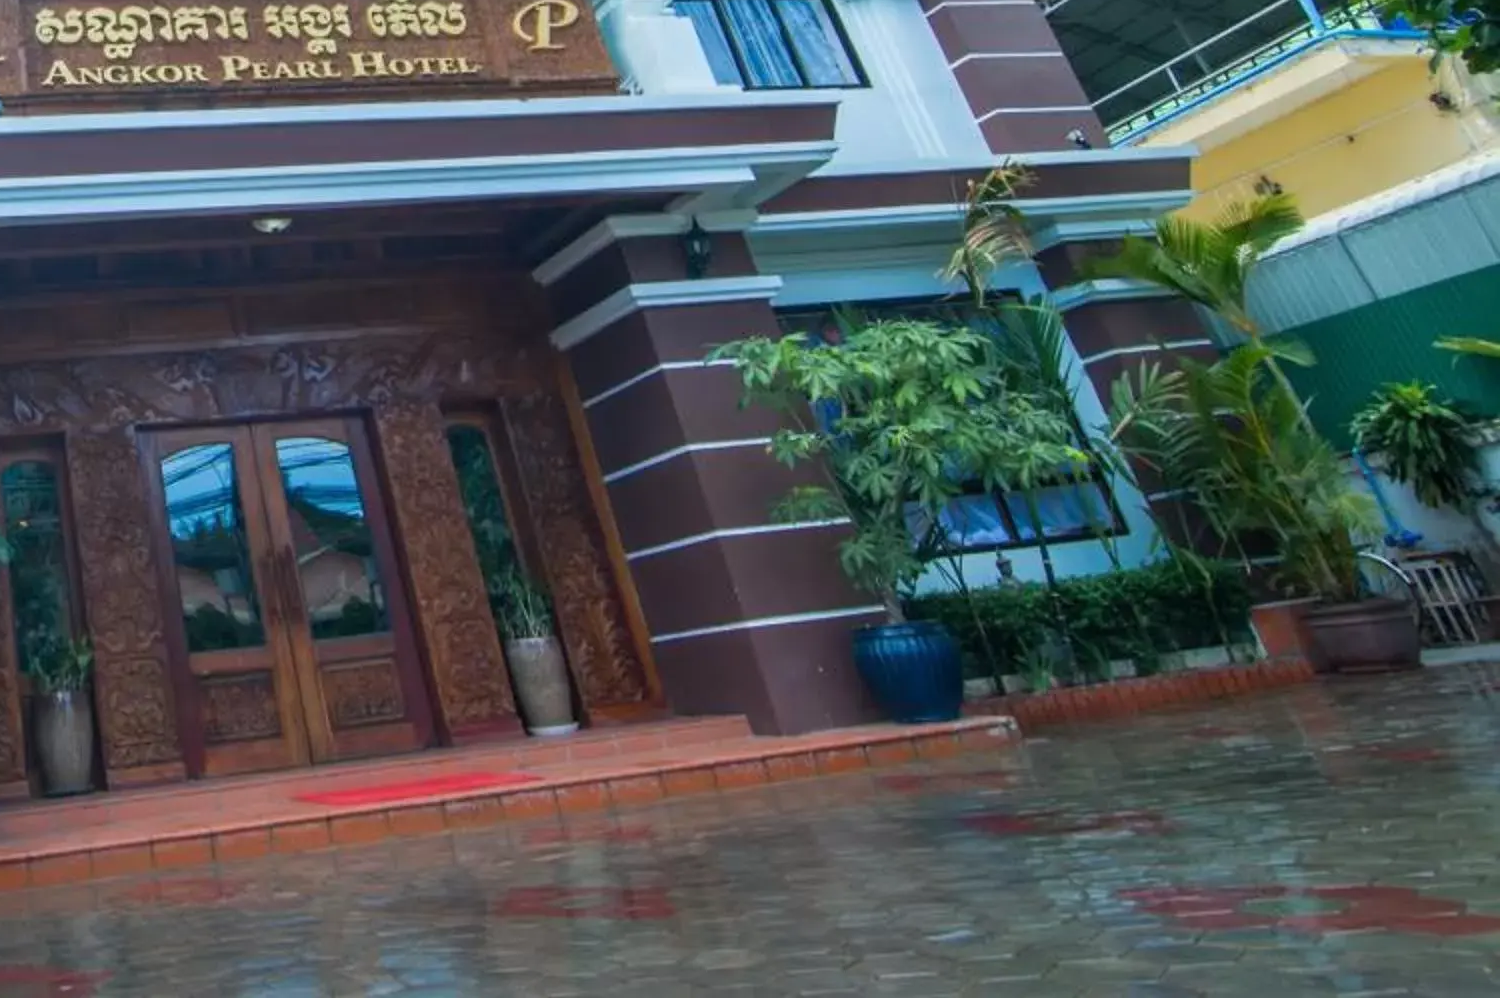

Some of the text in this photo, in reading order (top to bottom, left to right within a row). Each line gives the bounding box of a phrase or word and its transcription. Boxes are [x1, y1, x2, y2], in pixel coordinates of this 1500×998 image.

[263, 3, 352, 55] អង្គរ
[41, 51, 480, 86] ANGKOR PEARL HOTEL
